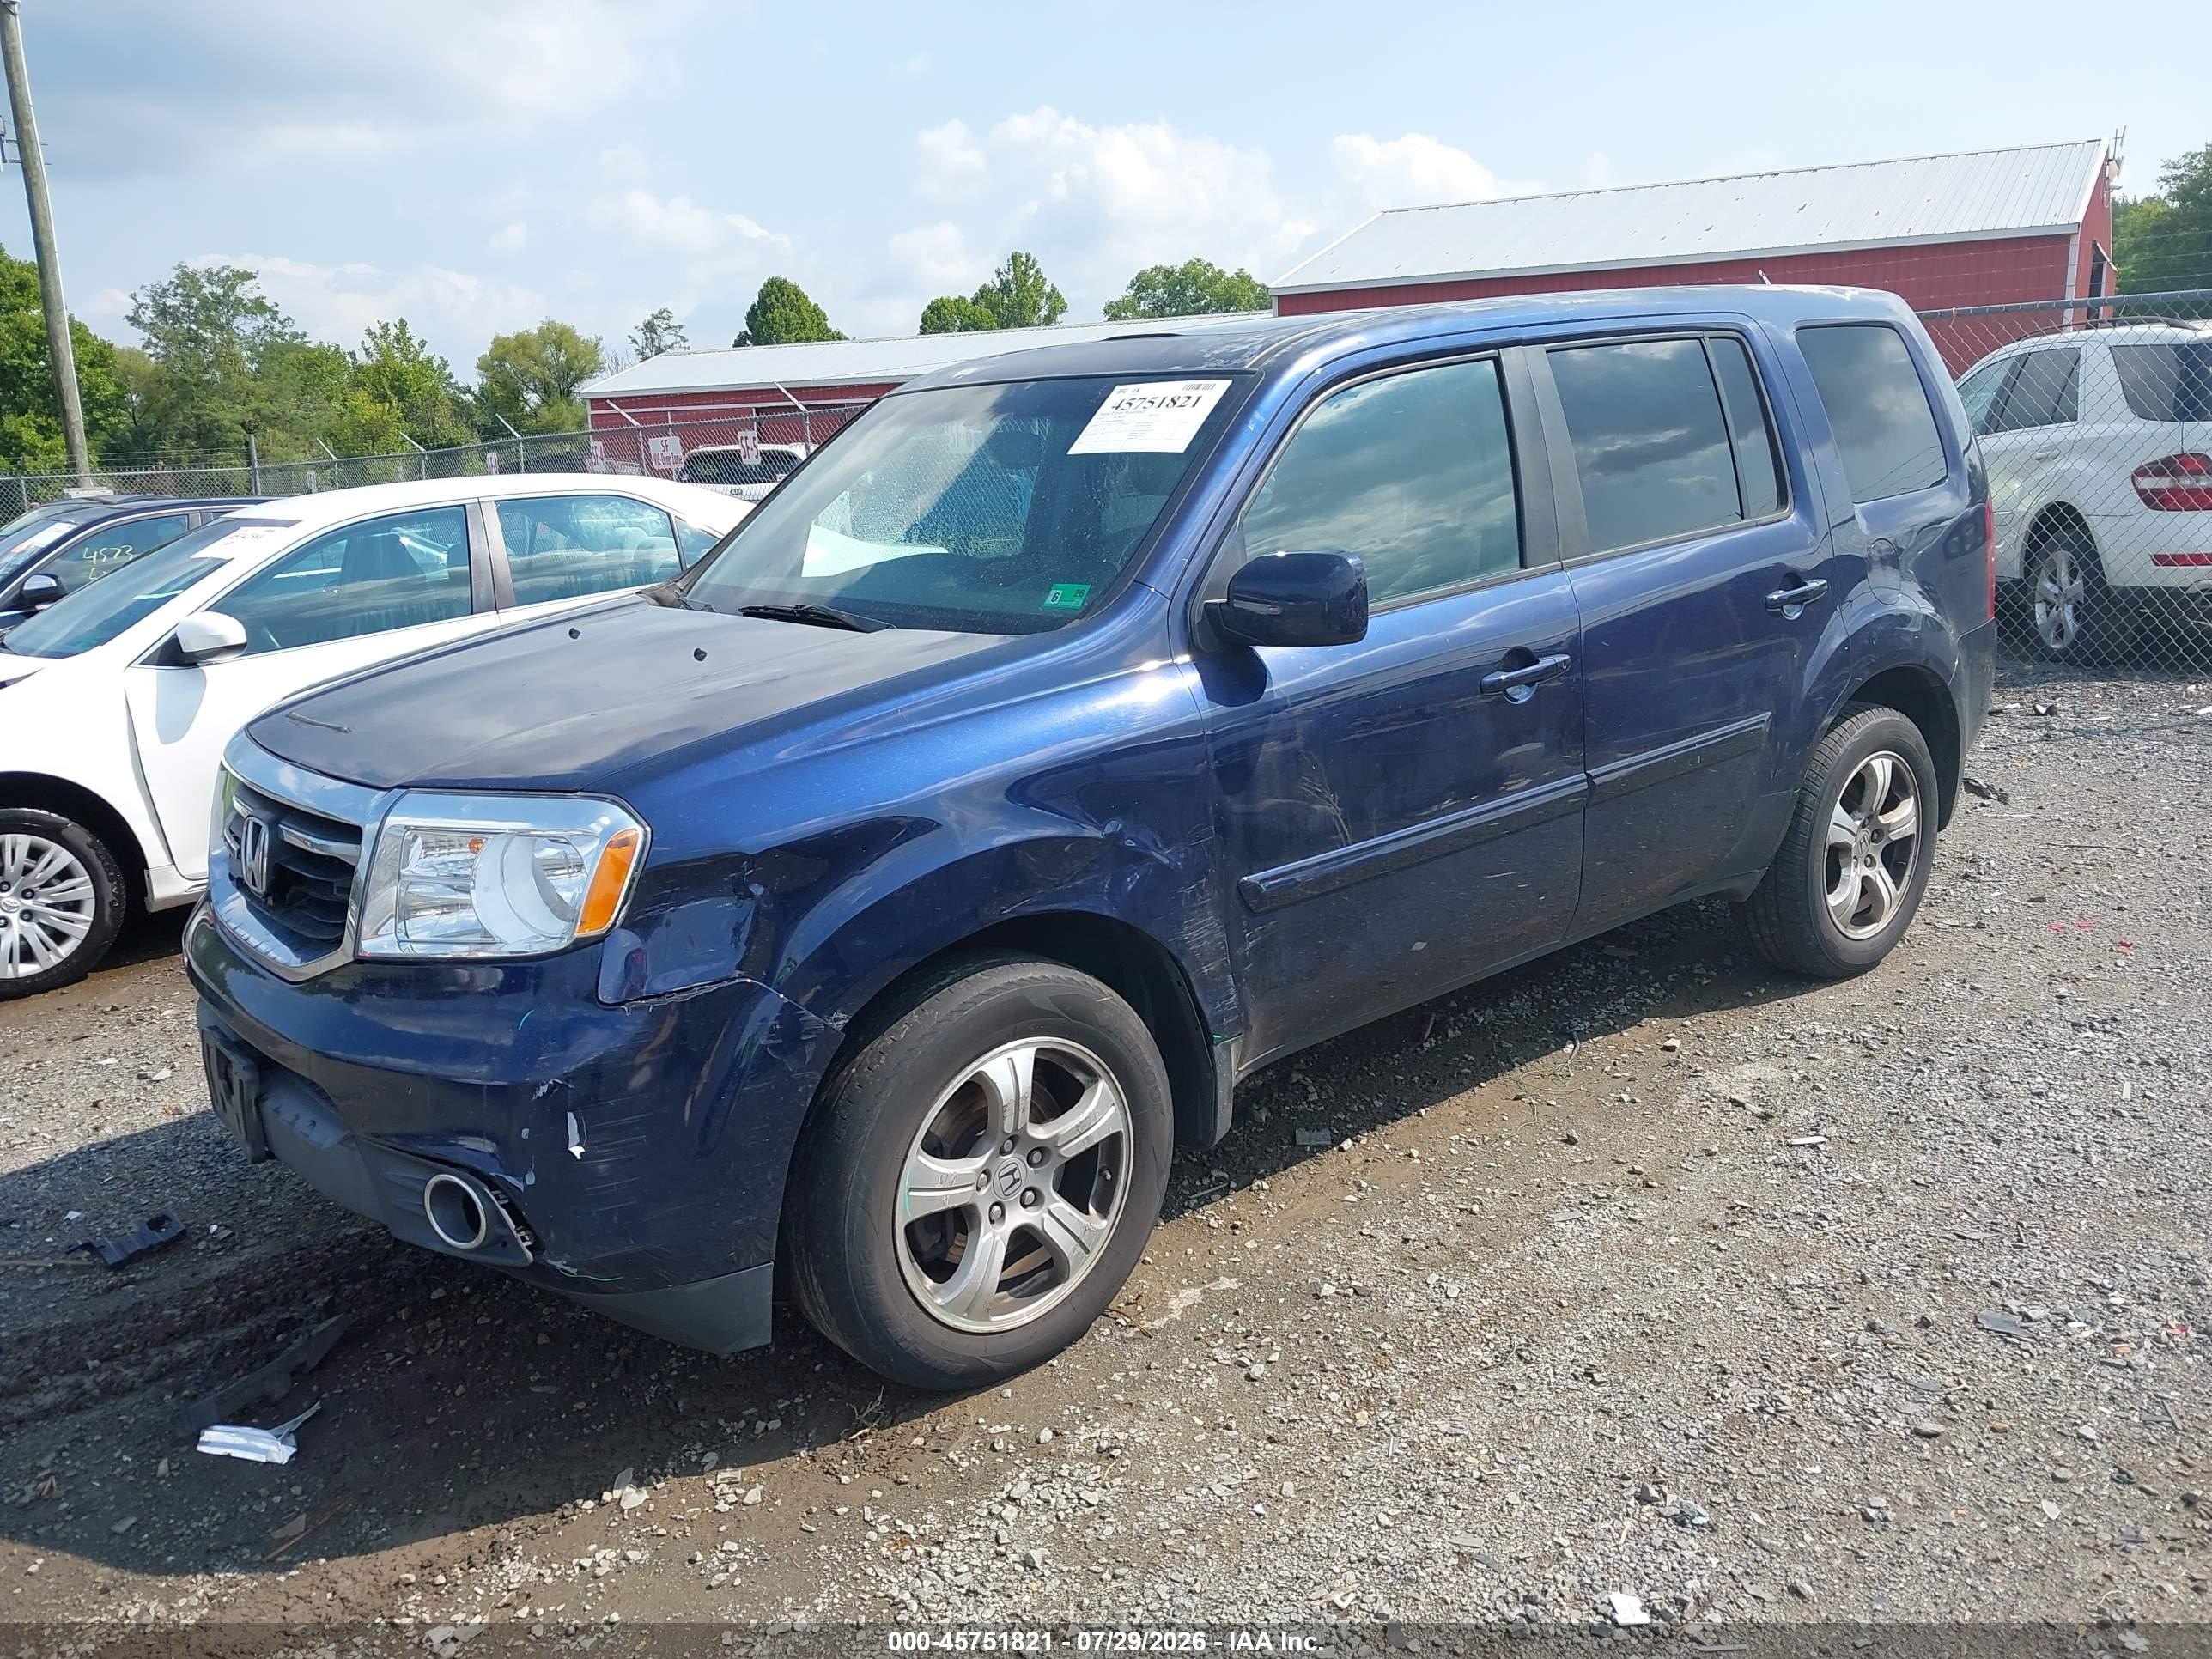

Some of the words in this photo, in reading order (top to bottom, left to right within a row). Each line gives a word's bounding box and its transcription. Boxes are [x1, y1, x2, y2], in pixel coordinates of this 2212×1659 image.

[1110, 395, 1203, 411] 45751821
[660, 439, 669, 453] SF
[1050, 592, 1060, 603] 6
